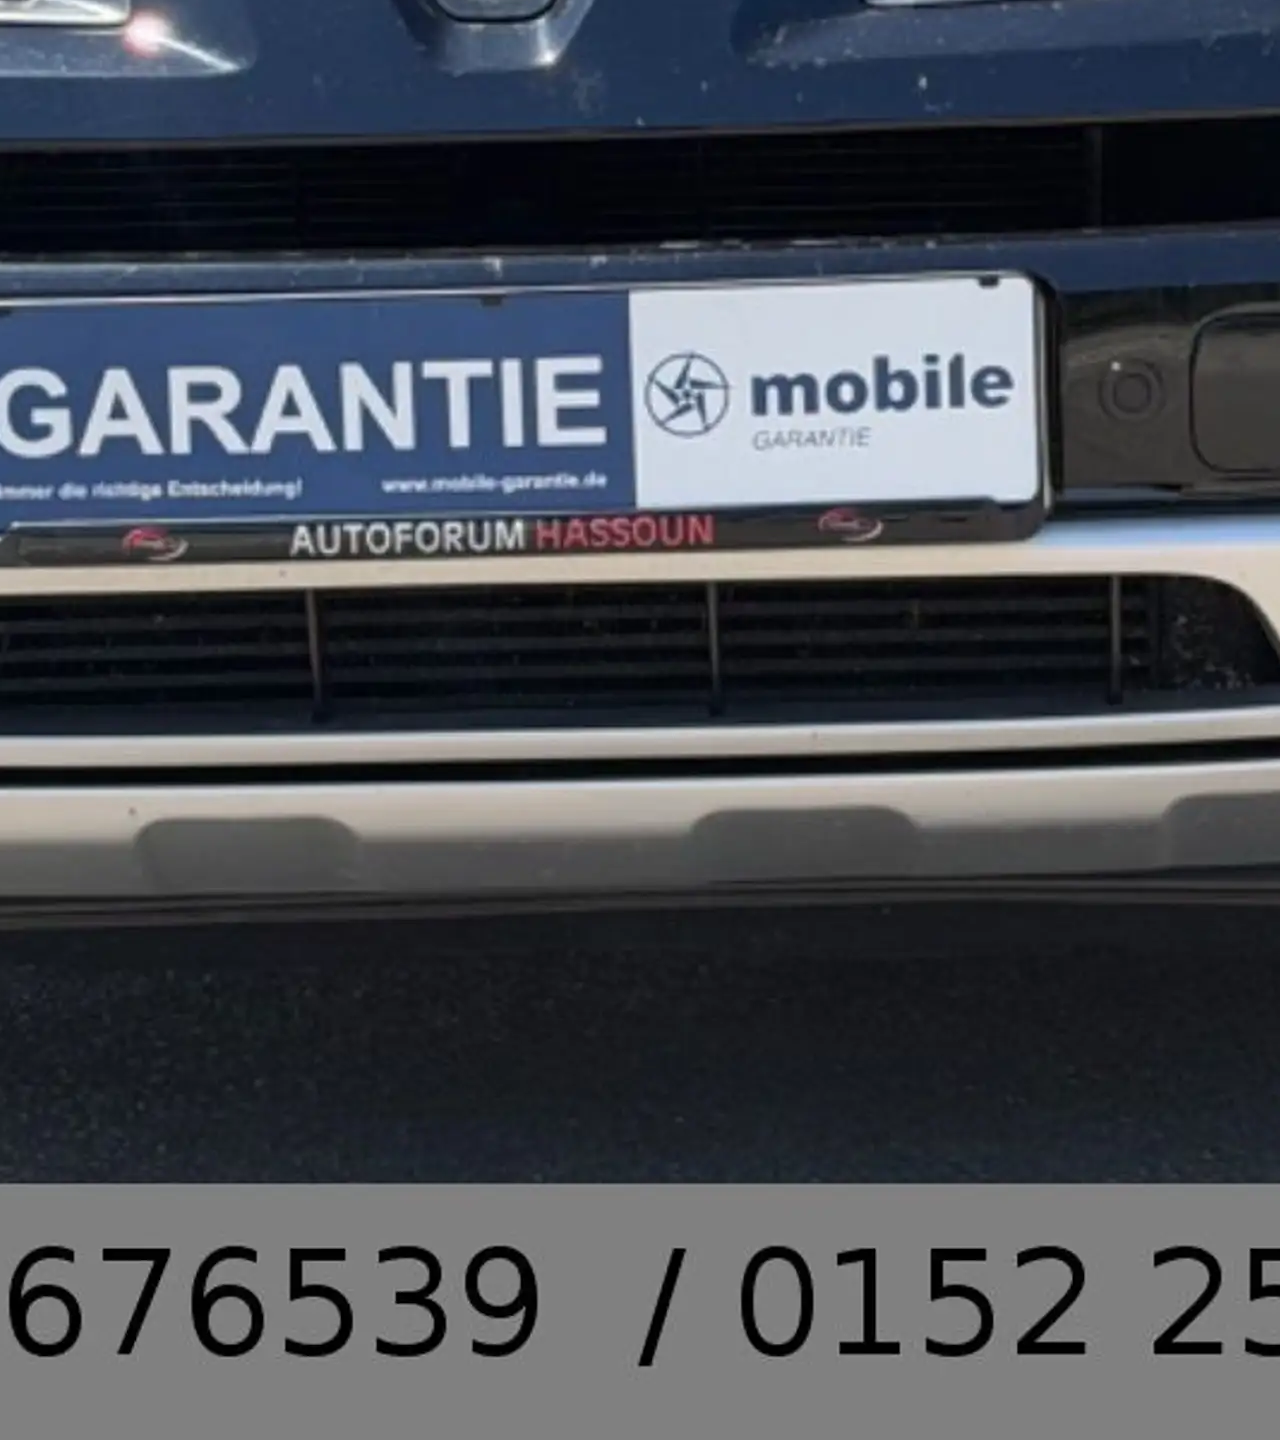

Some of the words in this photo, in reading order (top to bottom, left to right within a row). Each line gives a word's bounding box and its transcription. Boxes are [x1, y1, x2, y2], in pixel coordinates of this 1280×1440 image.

[750, 352, 1015, 417] mobile
[752, 426, 871, 451] GARANTIE
[57, 480, 88, 501] die
[380, 469, 608, 494] www.mobile-garantie.de
[289, 520, 526, 557] AUTOFORUM
[535, 514, 714, 549] HASSOUN
